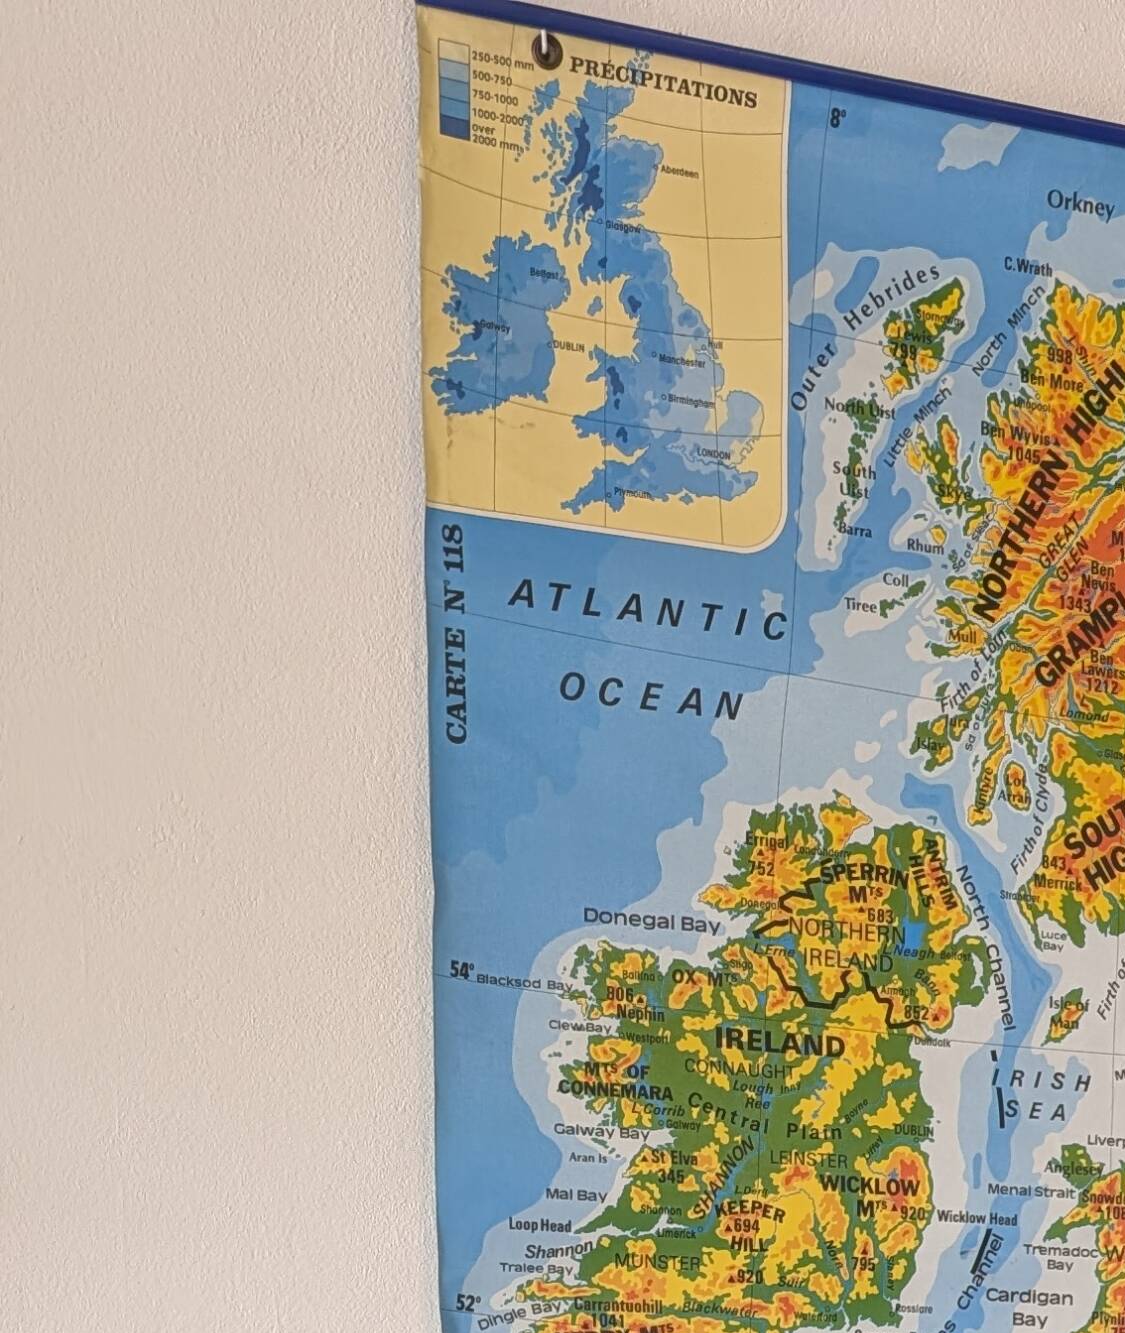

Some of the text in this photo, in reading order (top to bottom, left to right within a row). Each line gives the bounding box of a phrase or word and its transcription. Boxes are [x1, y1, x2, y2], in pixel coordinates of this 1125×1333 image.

[472, 51, 535, 71] 250-500 mm
[472, 70, 513, 86] 500-750
[569, 56, 758, 109] PRÉCIPITATIONS
[472, 89, 519, 106] 750-1000
[472, 108, 525, 127] 1000-2000
[472, 125, 495, 136] over
[472, 135, 519, 152] 2000 mm
[660, 164, 700, 179] Aberdeen
[1047, 189, 1116, 223] Orkney
[553, 340, 585, 352] DUBLIN
[791, 262, 941, 412] Outer Hebrides
[659, 354, 706, 369] Manchester
[825, 398, 896, 420] North Uist
[981, 421, 1051, 446] Ben Wyvis
[697, 449, 731, 461] LONDON
[1009, 448, 1041, 464] 1045
[833, 461, 876, 499] South Uist
[838, 522, 873, 539] Barra
[973, 452, 1069, 623] NORTHERN
[442, 523, 465, 573] 118
[907, 538, 945, 555] Rhum
[507, 578, 788, 641] ATLANTIC
[845, 598, 877, 613] Tiree
[445, 626, 468, 745] CARTE
[560, 671, 744, 721] OCEAN
[820, 862, 910, 889] SPERRIN
[1033, 874, 1082, 893] Merrick
[584, 908, 721, 937] Donegal Bay
[788, 917, 906, 946] NORTHERN
[957, 865, 1017, 1032] North Channel
[803, 948, 894, 973] IRELAND
[616, 1004, 665, 1024] Nephin
[715, 1026, 846, 1058] IRELAND
[557, 1079, 674, 1101] CONNEMARA
[992, 1068, 1092, 1092] IRISH
[1005, 1099, 1066, 1121] SEA
[554, 1122, 650, 1142] Galway Bay
[895, 1123, 934, 1138] DUBLIN
[1044, 1161, 1105, 1177] Anglesey
[820, 1174, 921, 1198] WICKLOW
[509, 1217, 572, 1233] Loop Head
[937, 1209, 1018, 1227] Wicklow Head
[614, 1253, 700, 1272] MUNSTER
[574, 1297, 663, 1314] Carrantuohill
[986, 1288, 1074, 1306] Cardigan
[1012, 1313, 1048, 1328] Bay
